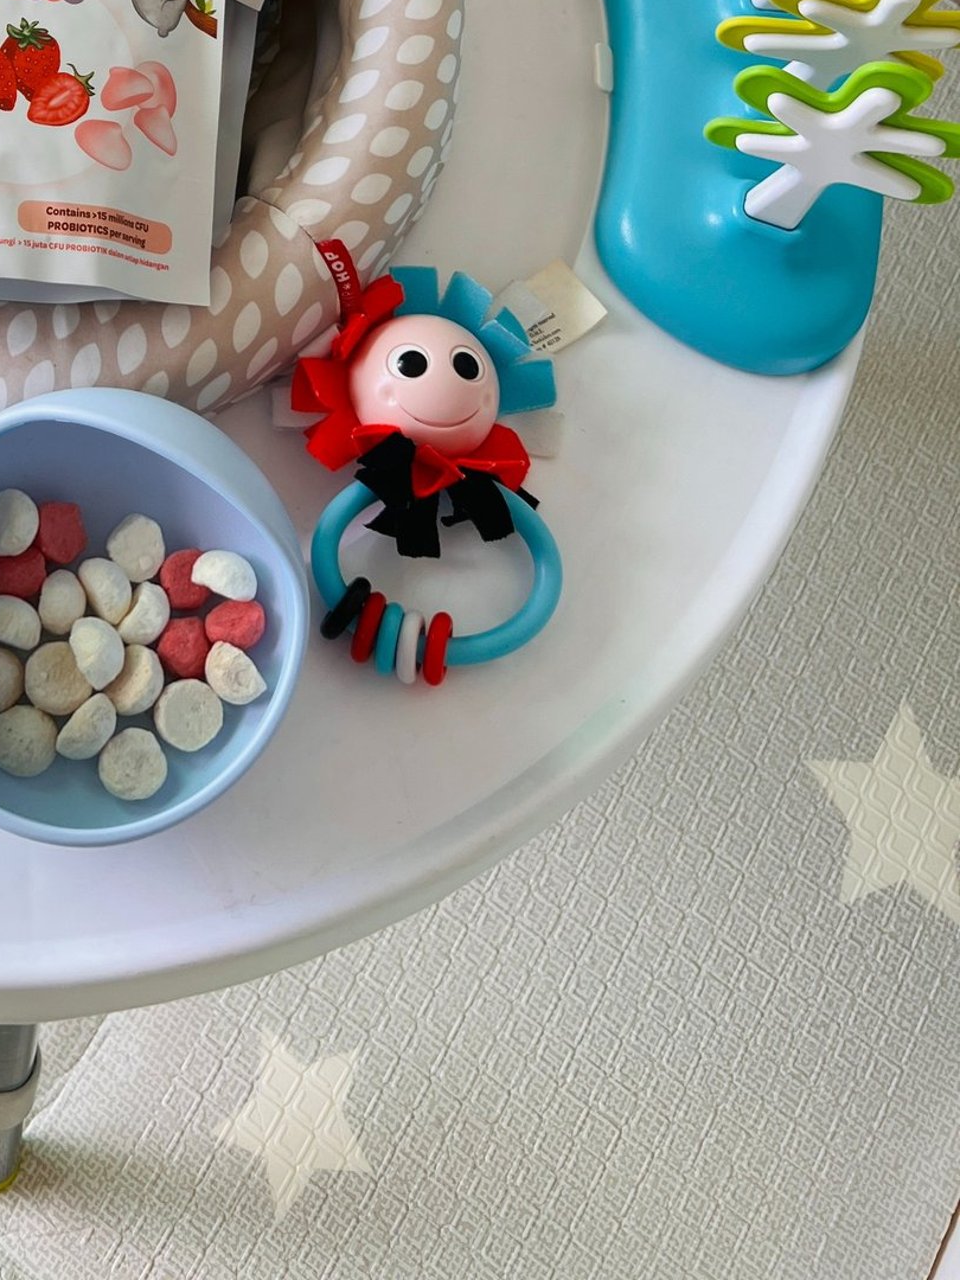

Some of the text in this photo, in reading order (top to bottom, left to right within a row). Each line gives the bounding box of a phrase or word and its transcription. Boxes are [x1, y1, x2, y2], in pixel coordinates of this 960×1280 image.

[46, 206, 91, 219] Contains
[135, 221, 149, 233] CFU
[47, 221, 146, 249] PROBIOTICS per serving
[48, 242, 65, 250] CFU
